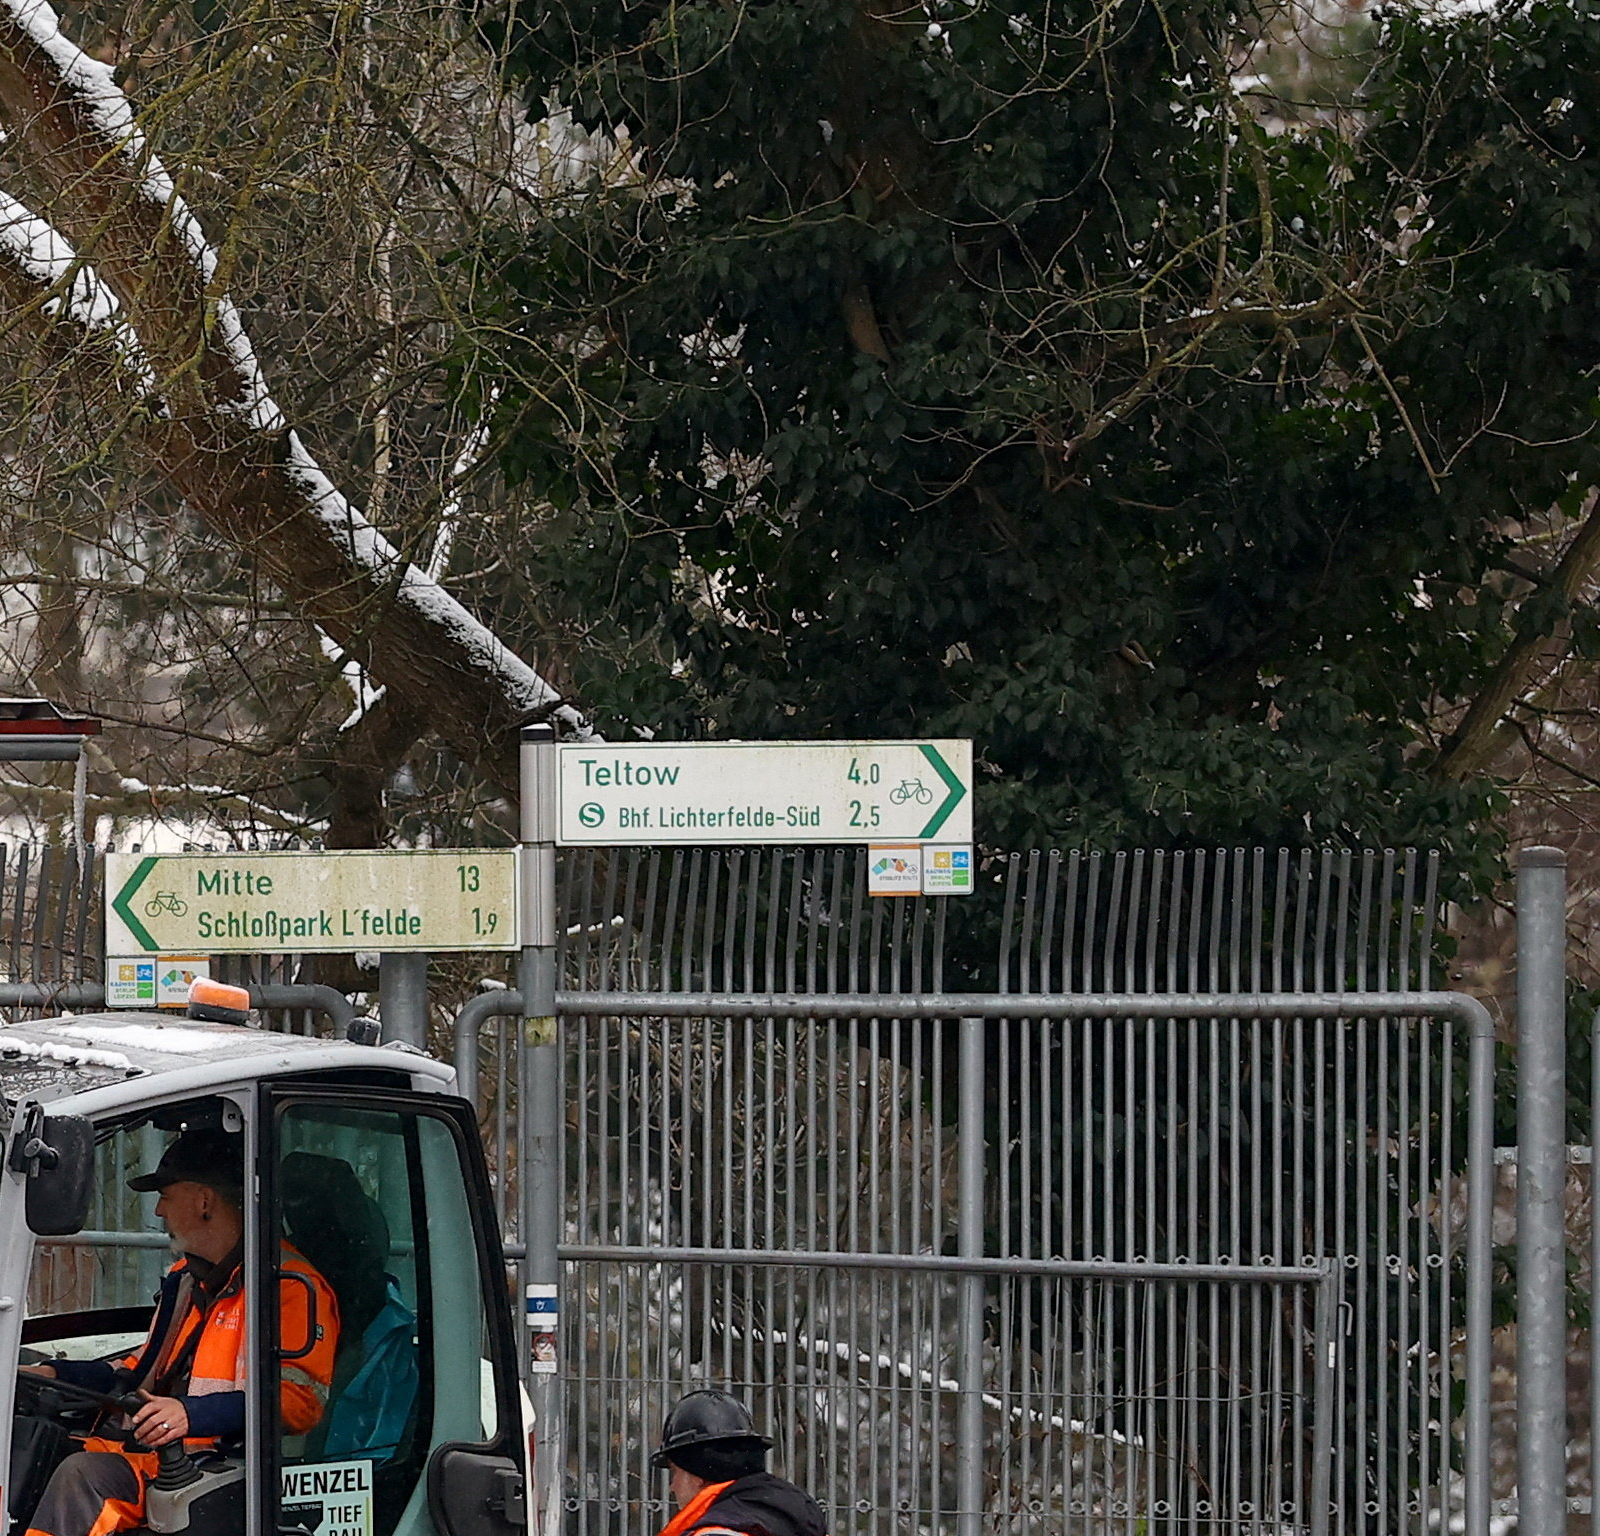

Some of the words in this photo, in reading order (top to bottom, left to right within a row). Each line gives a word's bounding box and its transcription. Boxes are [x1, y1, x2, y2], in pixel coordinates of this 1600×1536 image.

[578, 759, 680, 787] Teltow
[847, 757, 880, 787] 4,0
[619, 807, 654, 829] Bhf.
[659, 805, 821, 829] Lichterfelde-Süd
[849, 800, 881, 829] 2,5
[197, 869, 274, 896] Mitte
[456, 865, 481, 893] 13
[197, 910, 333, 944] Schloßpark
[472, 907, 498, 936] 1,9
[282, 1468, 369, 1497] WENZEL
[327, 1504, 362, 1524] TIEF
